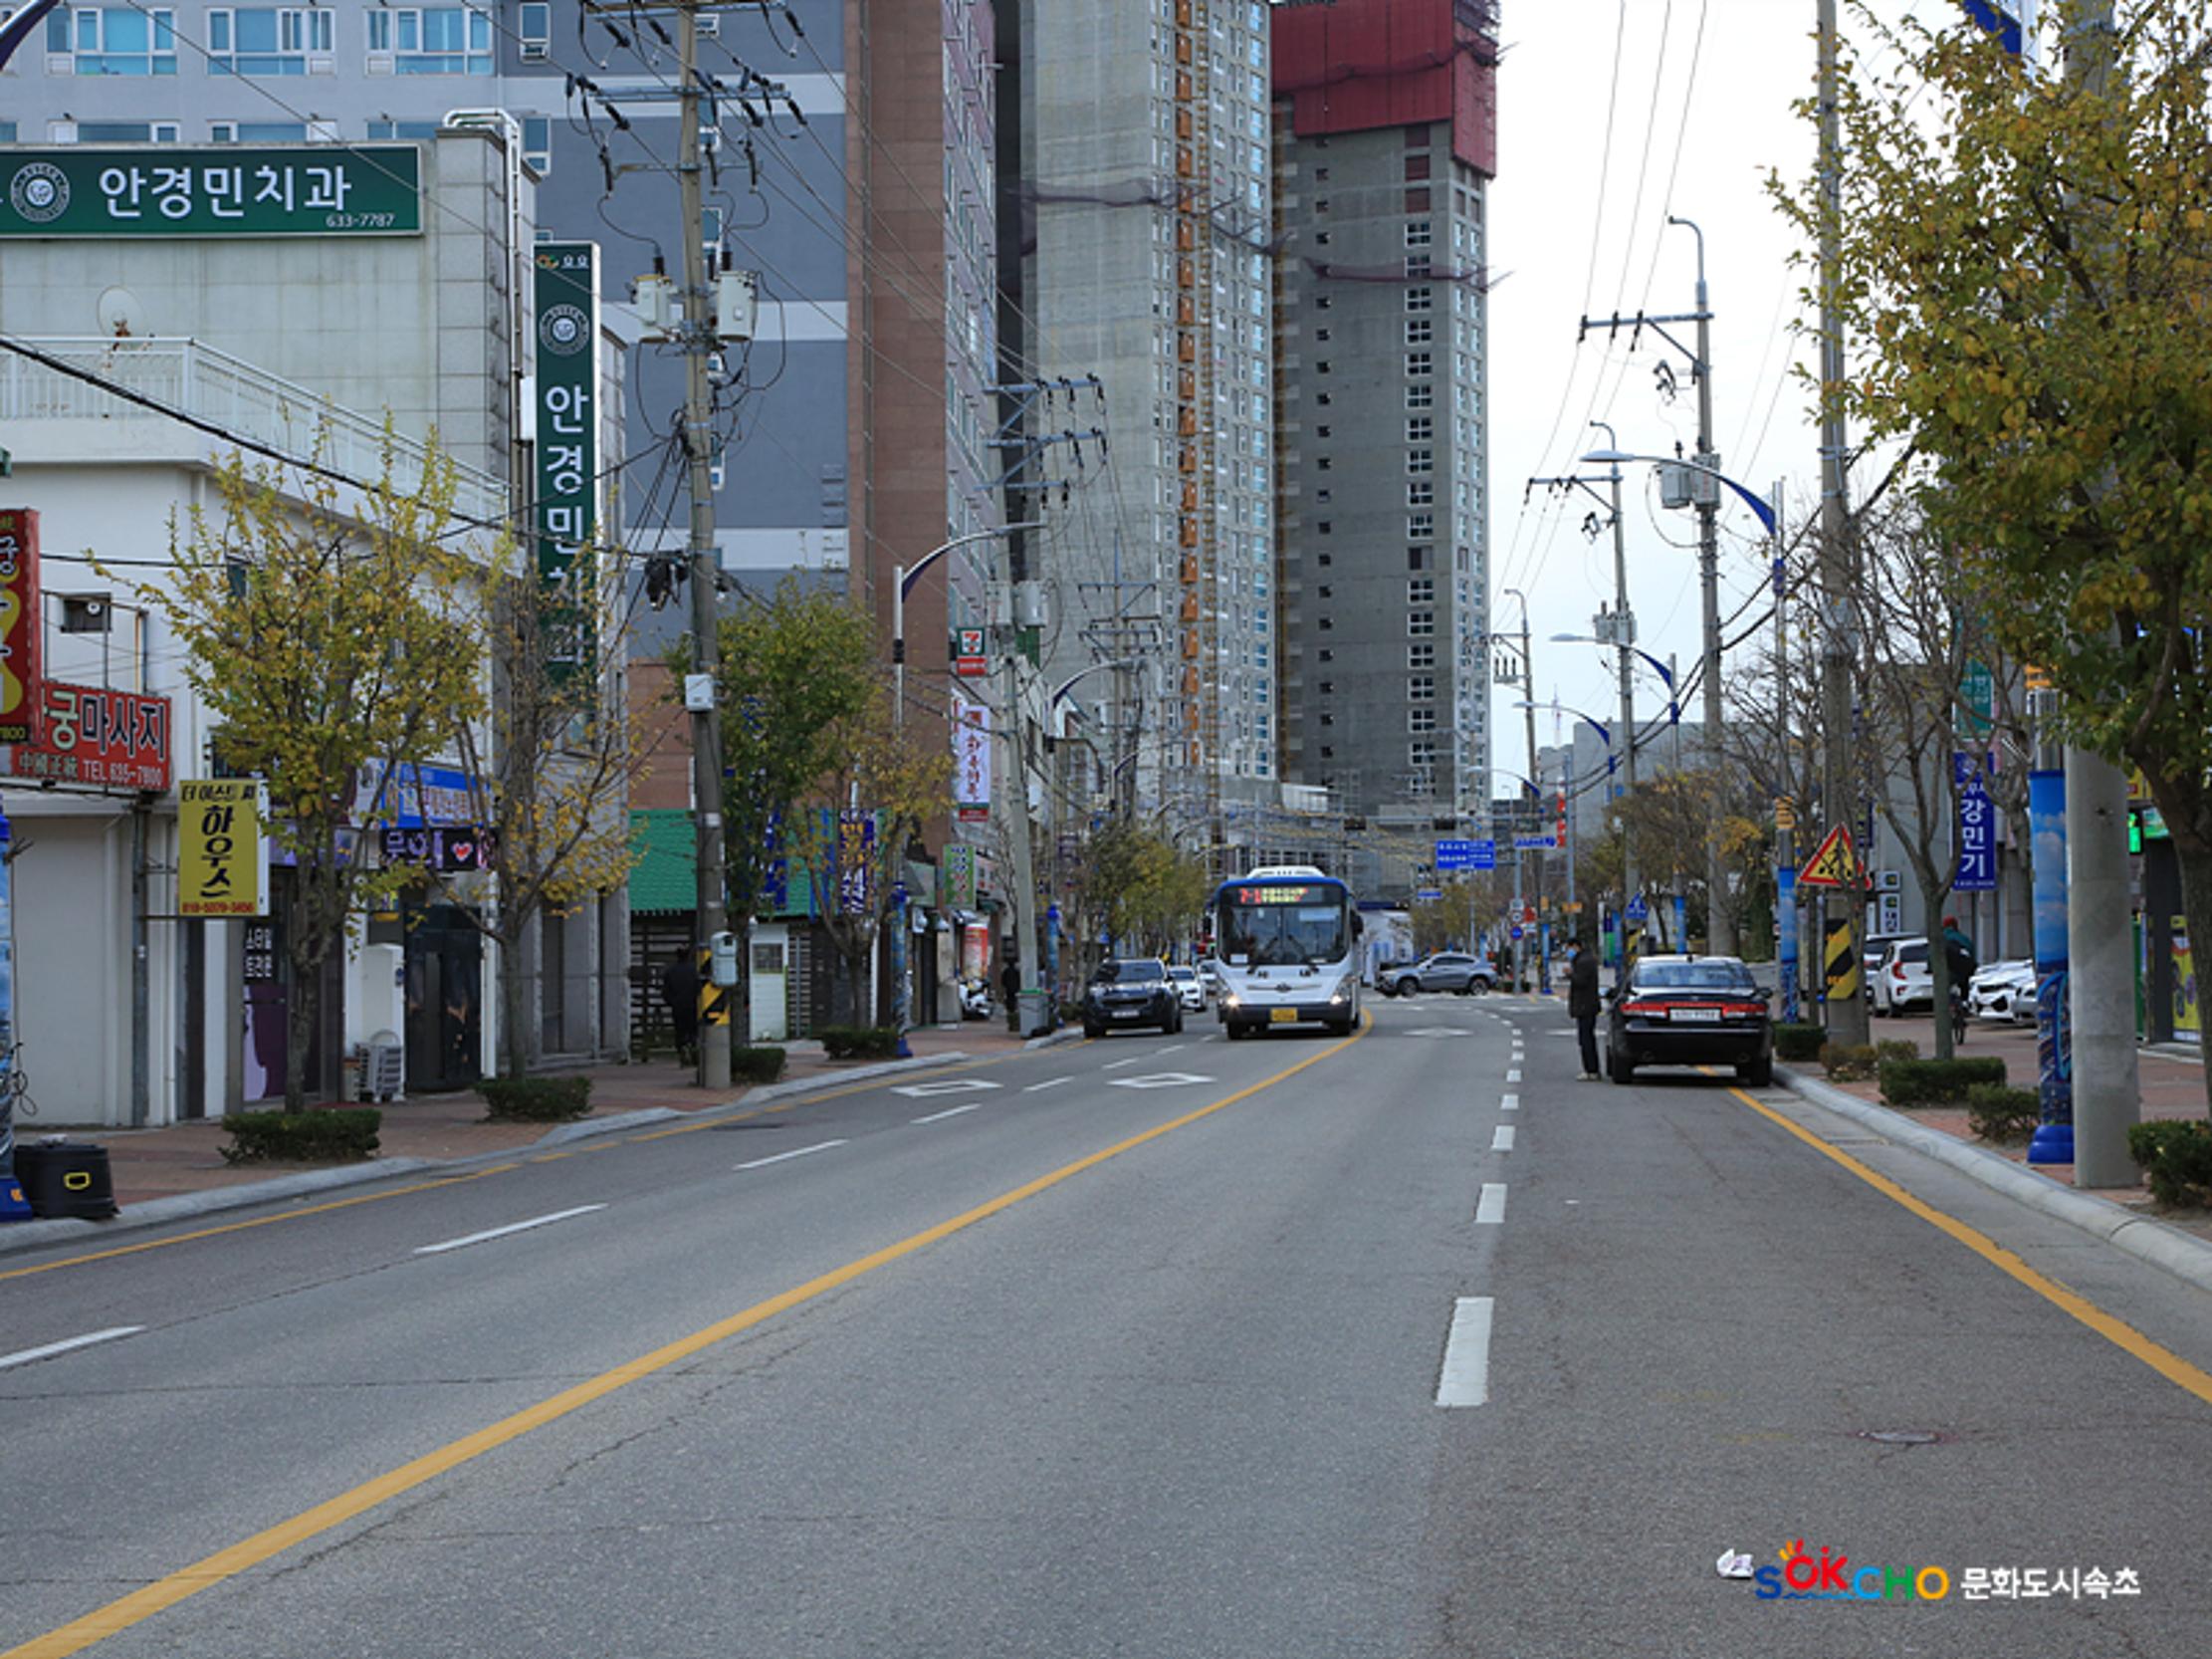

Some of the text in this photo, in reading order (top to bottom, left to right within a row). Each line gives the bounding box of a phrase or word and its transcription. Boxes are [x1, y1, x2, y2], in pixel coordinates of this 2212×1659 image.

[99, 164, 352, 219] 안경민치과
[325, 213, 396, 229] 633-7787
[44, 688, 166, 762] 궁마사지
[83, 759, 108, 783] TEL
[200, 804, 235, 898] 하우스
[1959, 799, 1987, 878] 강민기
